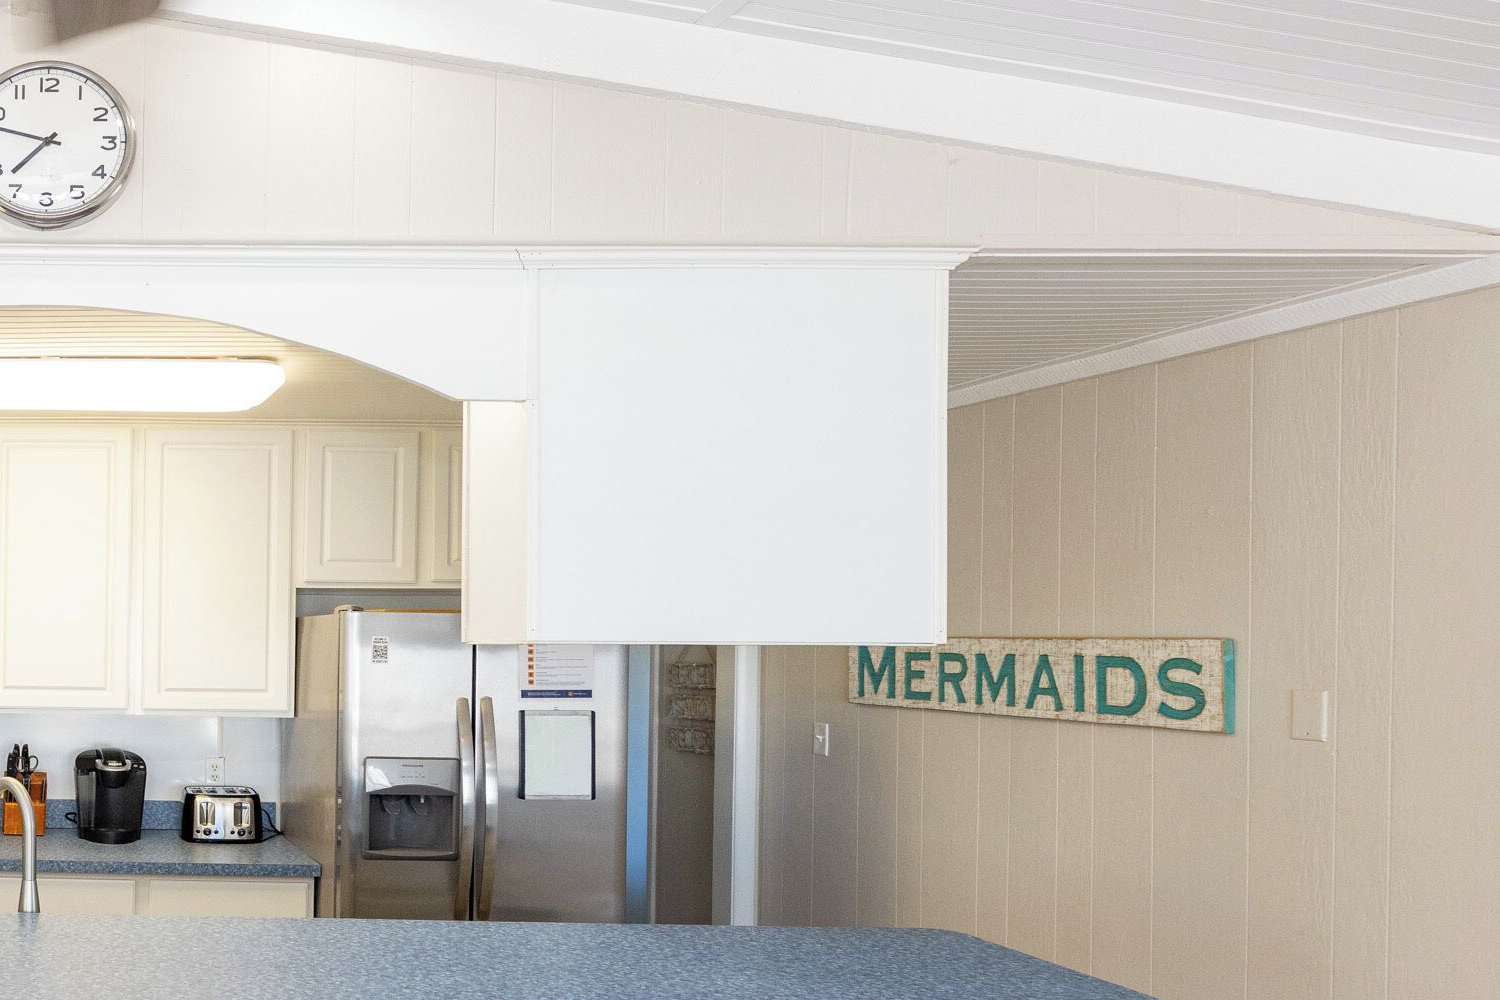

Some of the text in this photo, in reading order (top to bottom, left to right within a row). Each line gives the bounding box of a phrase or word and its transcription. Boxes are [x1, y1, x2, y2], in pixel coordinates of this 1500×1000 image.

[14, 84, 26, 100] 11
[39, 77, 60, 93] 12
[78, 85, 83, 101] 1
[92, 107, 109, 122] 2
[100, 135, 117, 151] 3
[91, 164, 107, 179] 4
[8, 184, 22, 199] 7
[38, 191, 54, 207] 6
[69, 184, 85, 200] 5
[857, 645, 1206, 721] MERMAIDS
